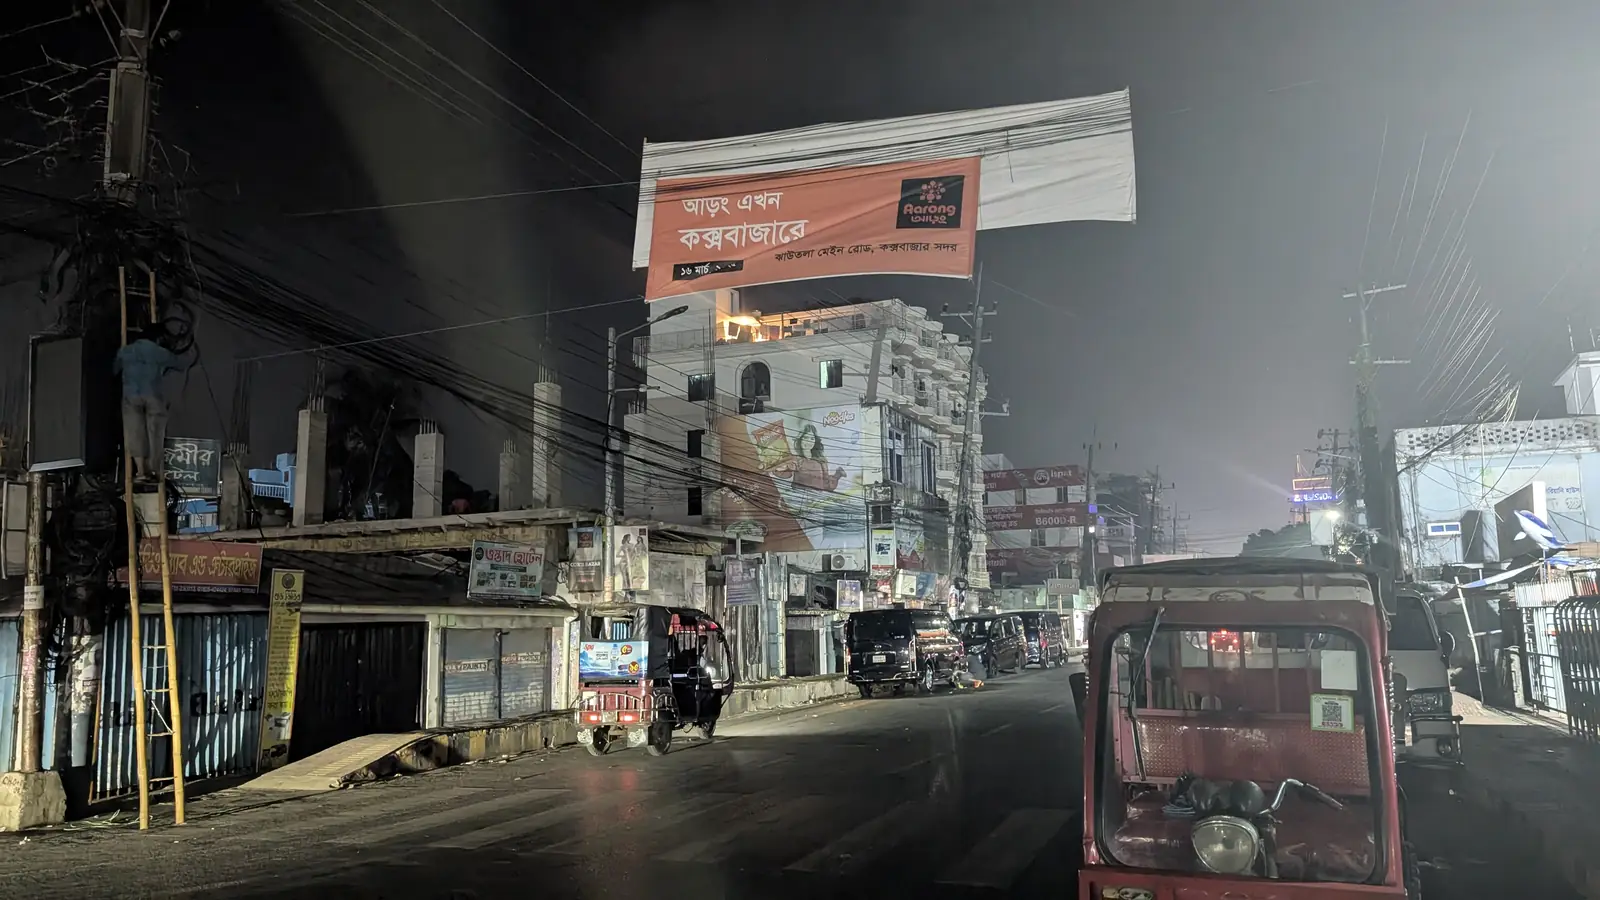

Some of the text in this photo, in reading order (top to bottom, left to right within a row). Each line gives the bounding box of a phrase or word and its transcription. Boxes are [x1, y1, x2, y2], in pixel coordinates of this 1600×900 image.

[682, 192, 784, 218] আড়ং এখন
[903, 202, 957, 216] Aarong
[678, 219, 809, 251] কক্সবাজারে
[817, 245, 845, 257] মেইন
[847, 243, 876, 254] রোড,
[879, 242, 930, 253] কক্সবাজার
[933, 242, 958, 252] সদর
[680, 266, 692, 276] ১৬
[823, 411, 856, 427] Noodles
[514, 548, 543, 565] হোটেল
